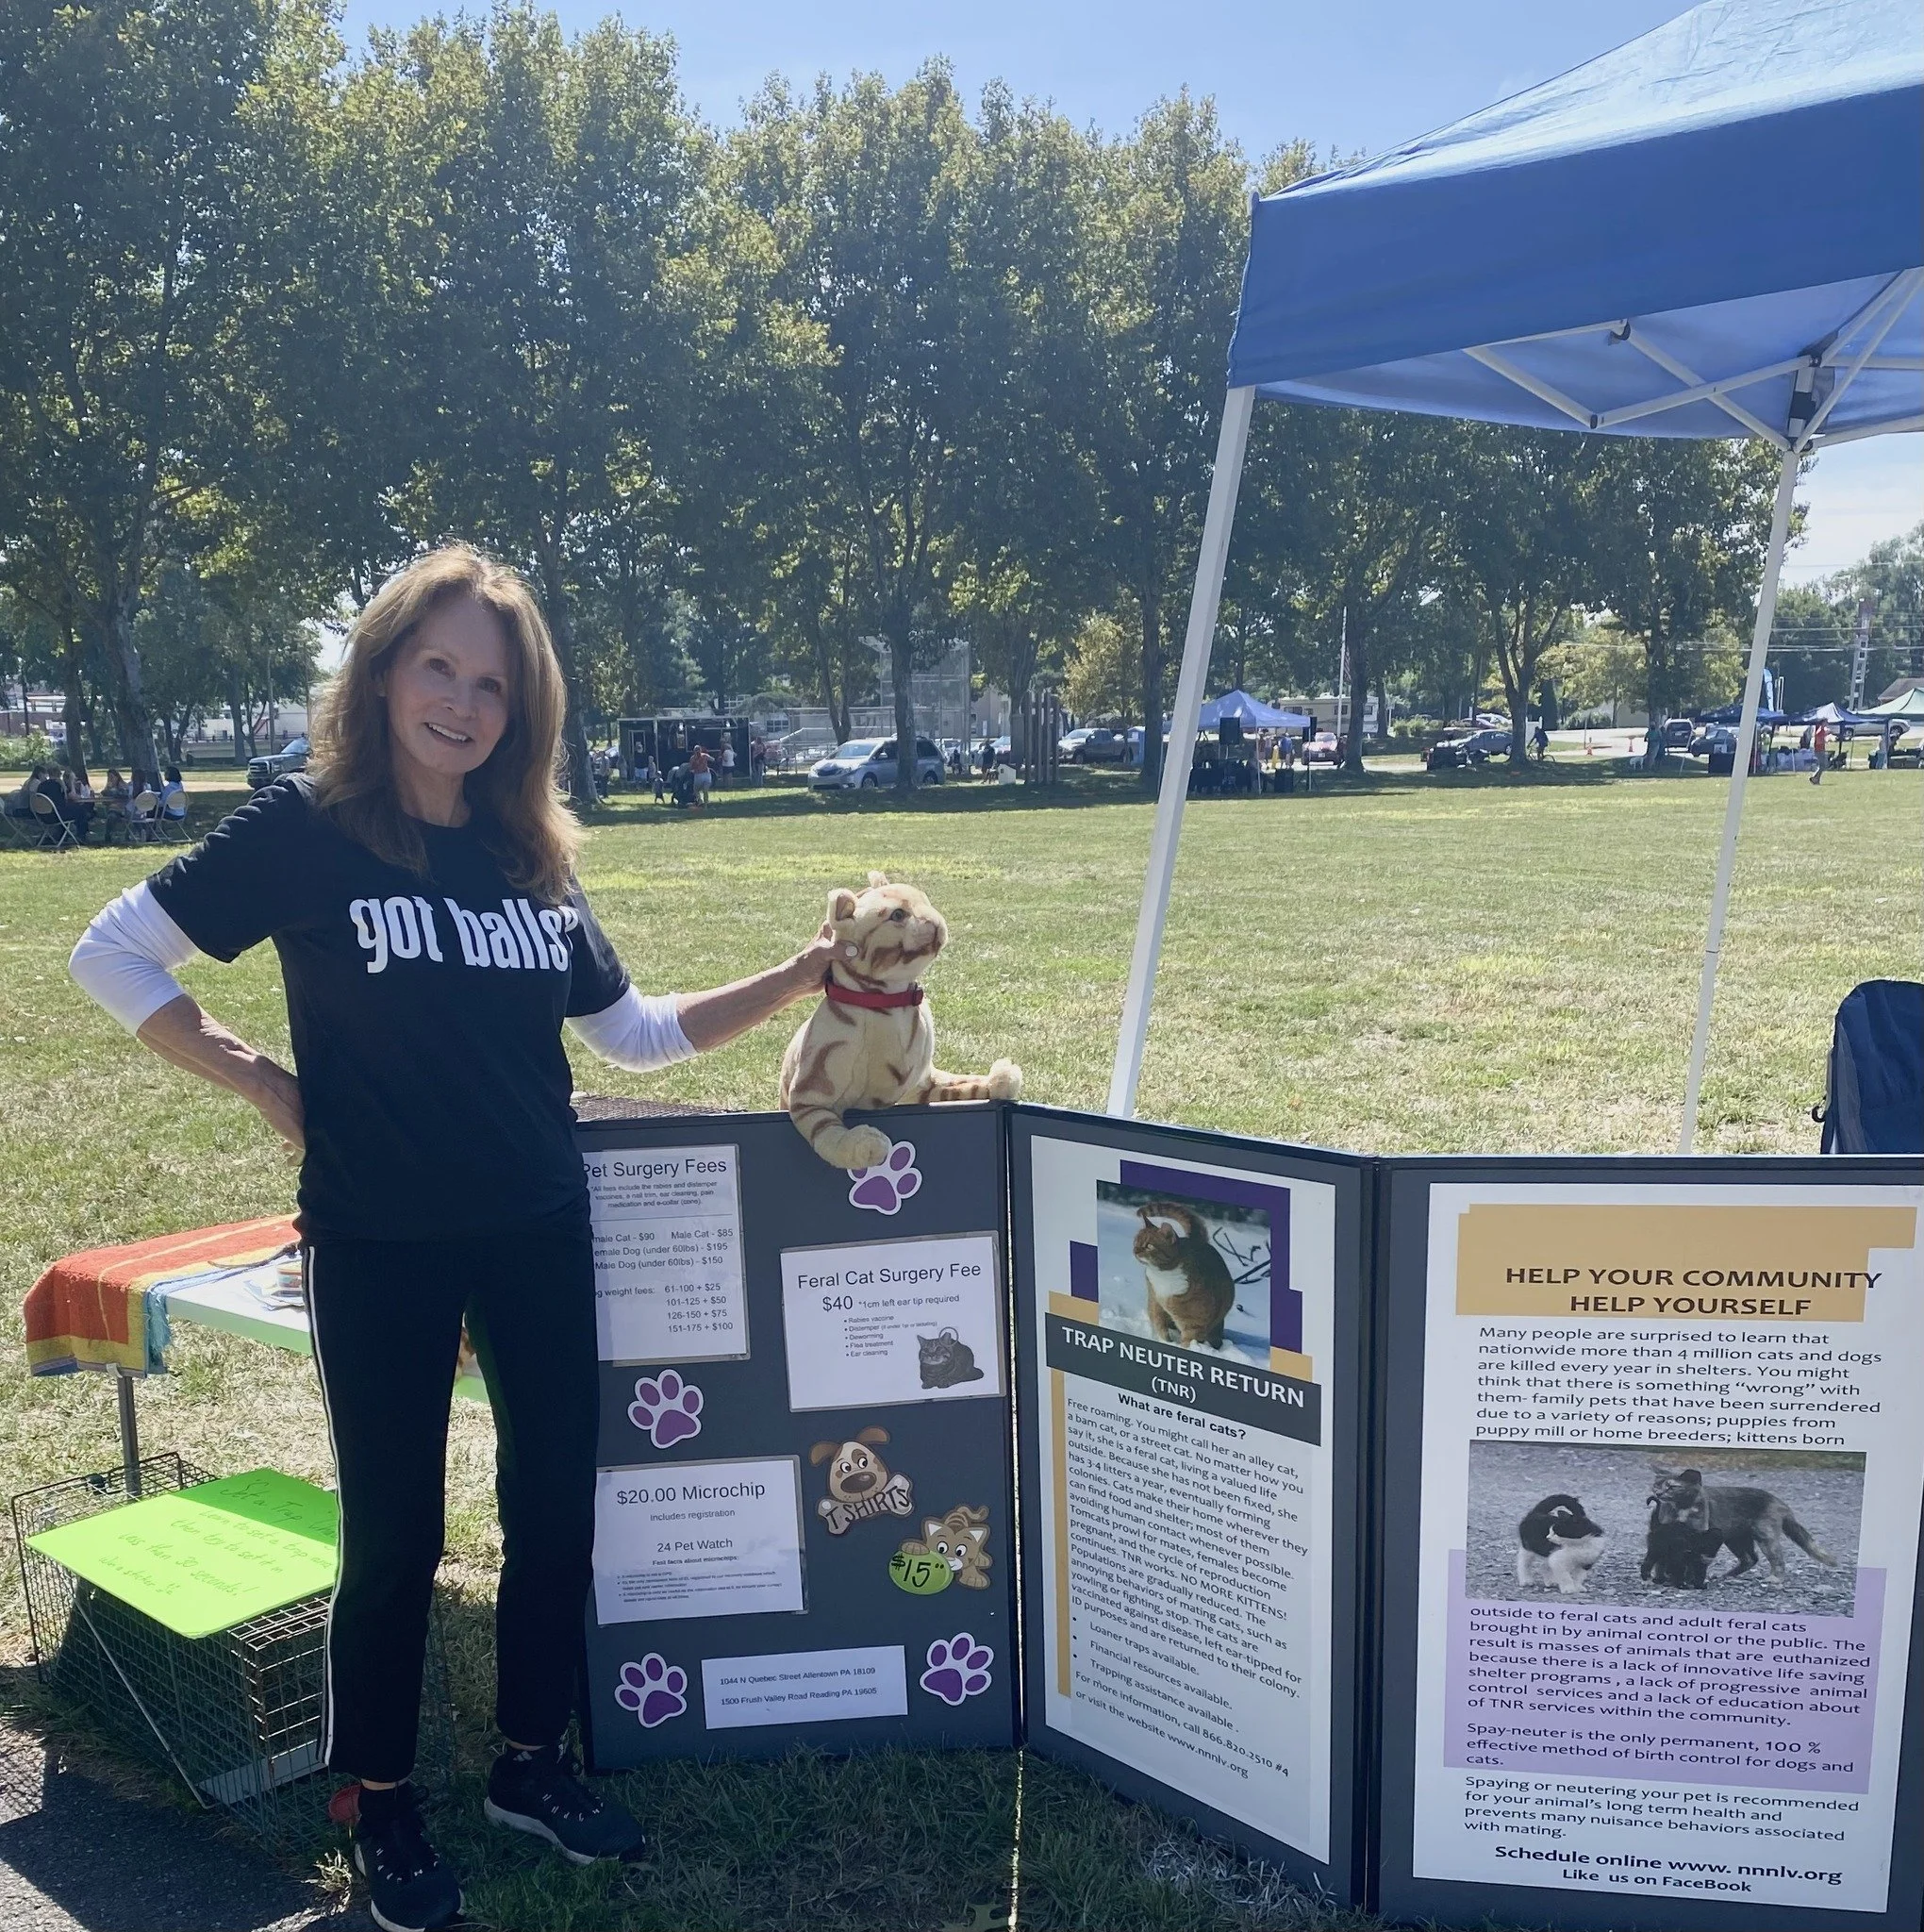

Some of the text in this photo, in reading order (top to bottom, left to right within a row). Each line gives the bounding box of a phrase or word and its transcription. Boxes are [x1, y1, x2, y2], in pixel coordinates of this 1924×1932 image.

[349, 896, 442, 973] got
[613, 1161, 680, 1180] Surgery
[685, 1158, 727, 1174] Fees
[593, 1234, 614, 1243] male
[615, 1233, 631, 1242] Cat
[639, 1232, 655, 1241] $90
[671, 1230, 692, 1240] Male
[693, 1229, 710, 1239] Cat
[717, 1228, 734, 1238] $85
[593, 1248, 621, 1257] emale
[622, 1246, 640, 1257] Dog
[642, 1245, 671, 1257] (under
[672, 1243, 699, 1254] 60lbs)
[705, 1241, 728, 1252] $195
[595, 1261, 616, 1270] Male
[618, 1260, 637, 1271] Dog
[638, 1259, 666, 1270] (under
[667, 1257, 694, 1268] 60lbs)
[701, 1256, 723, 1266] $150
[798, 1262, 982, 1290] Feral Cat Surgery Fee
[1506, 1268, 1883, 1289] HELP YOUR COMMUNITY
[604, 1288, 633, 1298] weight
[634, 1286, 655, 1295] fees:
[664, 1284, 695, 1293] 61-100
[705, 1282, 722, 1292] $25
[666, 1296, 701, 1307] 101-125
[710, 1295, 727, 1305] $50
[822, 1295, 854, 1313] $40
[881, 1298, 896, 1307] left
[896, 1298, 911, 1307] ear
[912, 1297, 923, 1307] tip
[924, 1294, 960, 1305] required
[1570, 1295, 1812, 1316] HELP YOURSELF
[667, 1310, 702, 1320] 126-150
[710, 1308, 728, 1319] $75
[668, 1324, 703, 1333] 151-175
[712, 1322, 734, 1331] $100
[1061, 1325, 1304, 1408] TRAP NEUTER RETURN
[1152, 1375, 1196, 1404] (TNR)
[1118, 1392, 1247, 1441] What are feral cats?
[617, 1481, 766, 1506] $20.00 Microchip
[650, 1509, 736, 1522] Includes registration
[656, 1538, 733, 1553] 24 Pet Watch
[720, 1676, 738, 1686] 1044
[748, 1675, 777, 1685] Quebec
[778, 1673, 802, 1681] Street
[802, 1671, 839, 1679] Allentown
[839, 1668, 852, 1676] PA
[853, 1667, 876, 1676] 18109
[721, 1697, 740, 1706] 1500
[740, 1695, 763, 1704] Frush
[763, 1694, 787, 1703] Valley
[788, 1691, 808, 1701] Road
[809, 1690, 840, 1699] Reading
[854, 1687, 877, 1696] 19605
[1075, 1671, 1289, 1777] For more information, call 866.820.2510 #4
[1075, 1690, 1249, 1779] or visit the website www.nnnlv.org
[1495, 1846, 1843, 1886] Schedule online www. nnnlv.org
[1563, 1869, 1752, 1892] Like us on FaceBook
